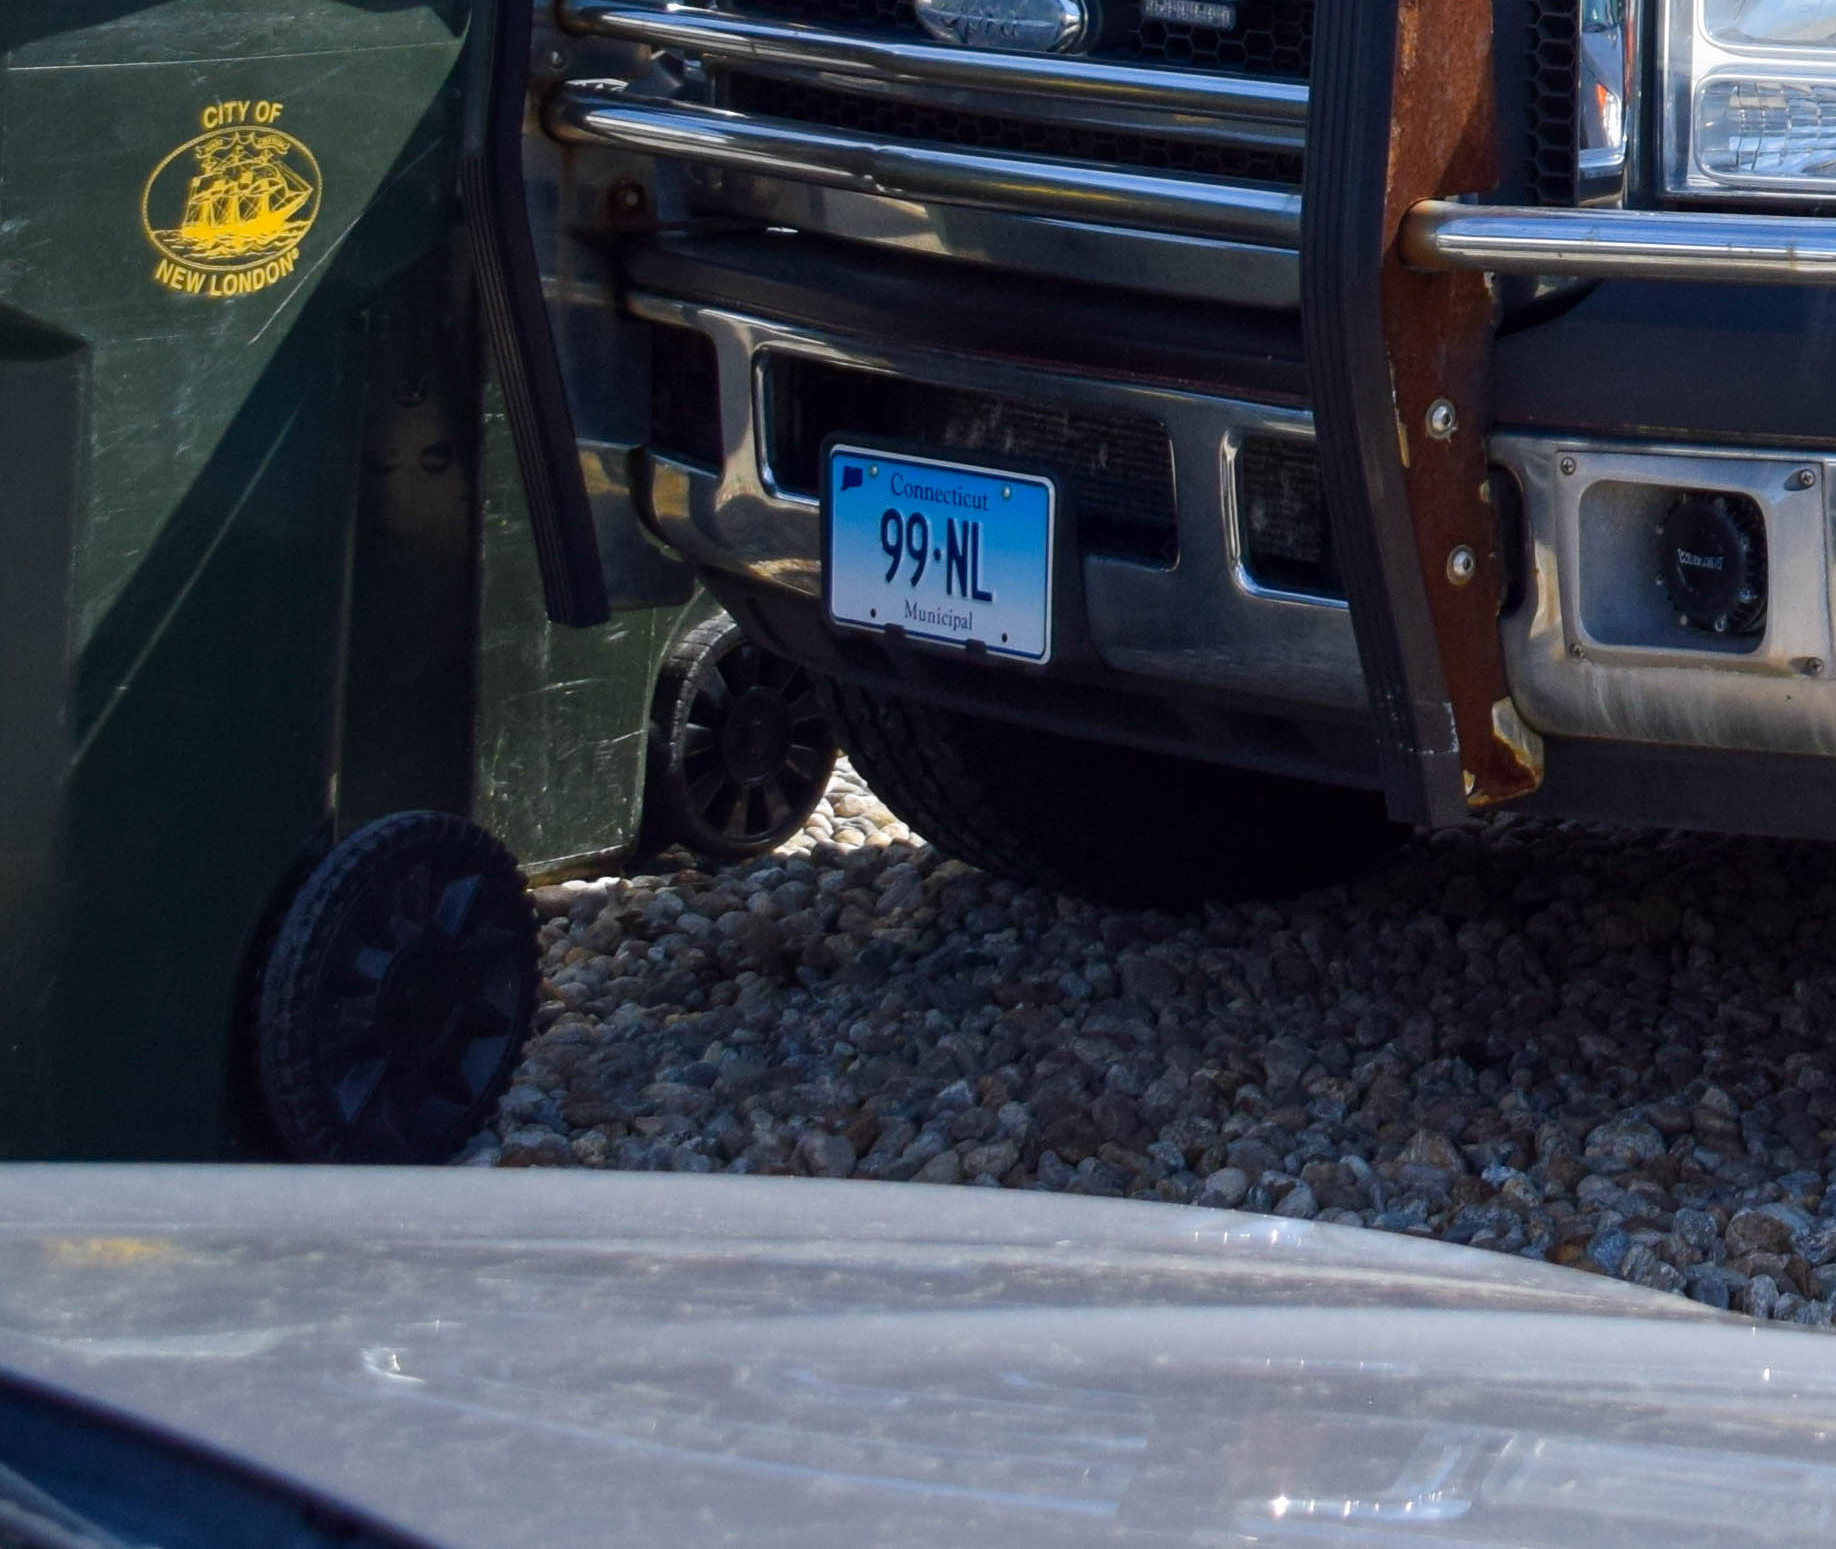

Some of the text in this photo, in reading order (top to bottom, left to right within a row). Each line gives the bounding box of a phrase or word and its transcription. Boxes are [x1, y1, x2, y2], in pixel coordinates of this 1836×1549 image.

[203, 100, 285, 129] CITY OF
[155, 258, 207, 295] NEW
[890, 472, 989, 511] Connecticut
[904, 600, 973, 631] Municipal
